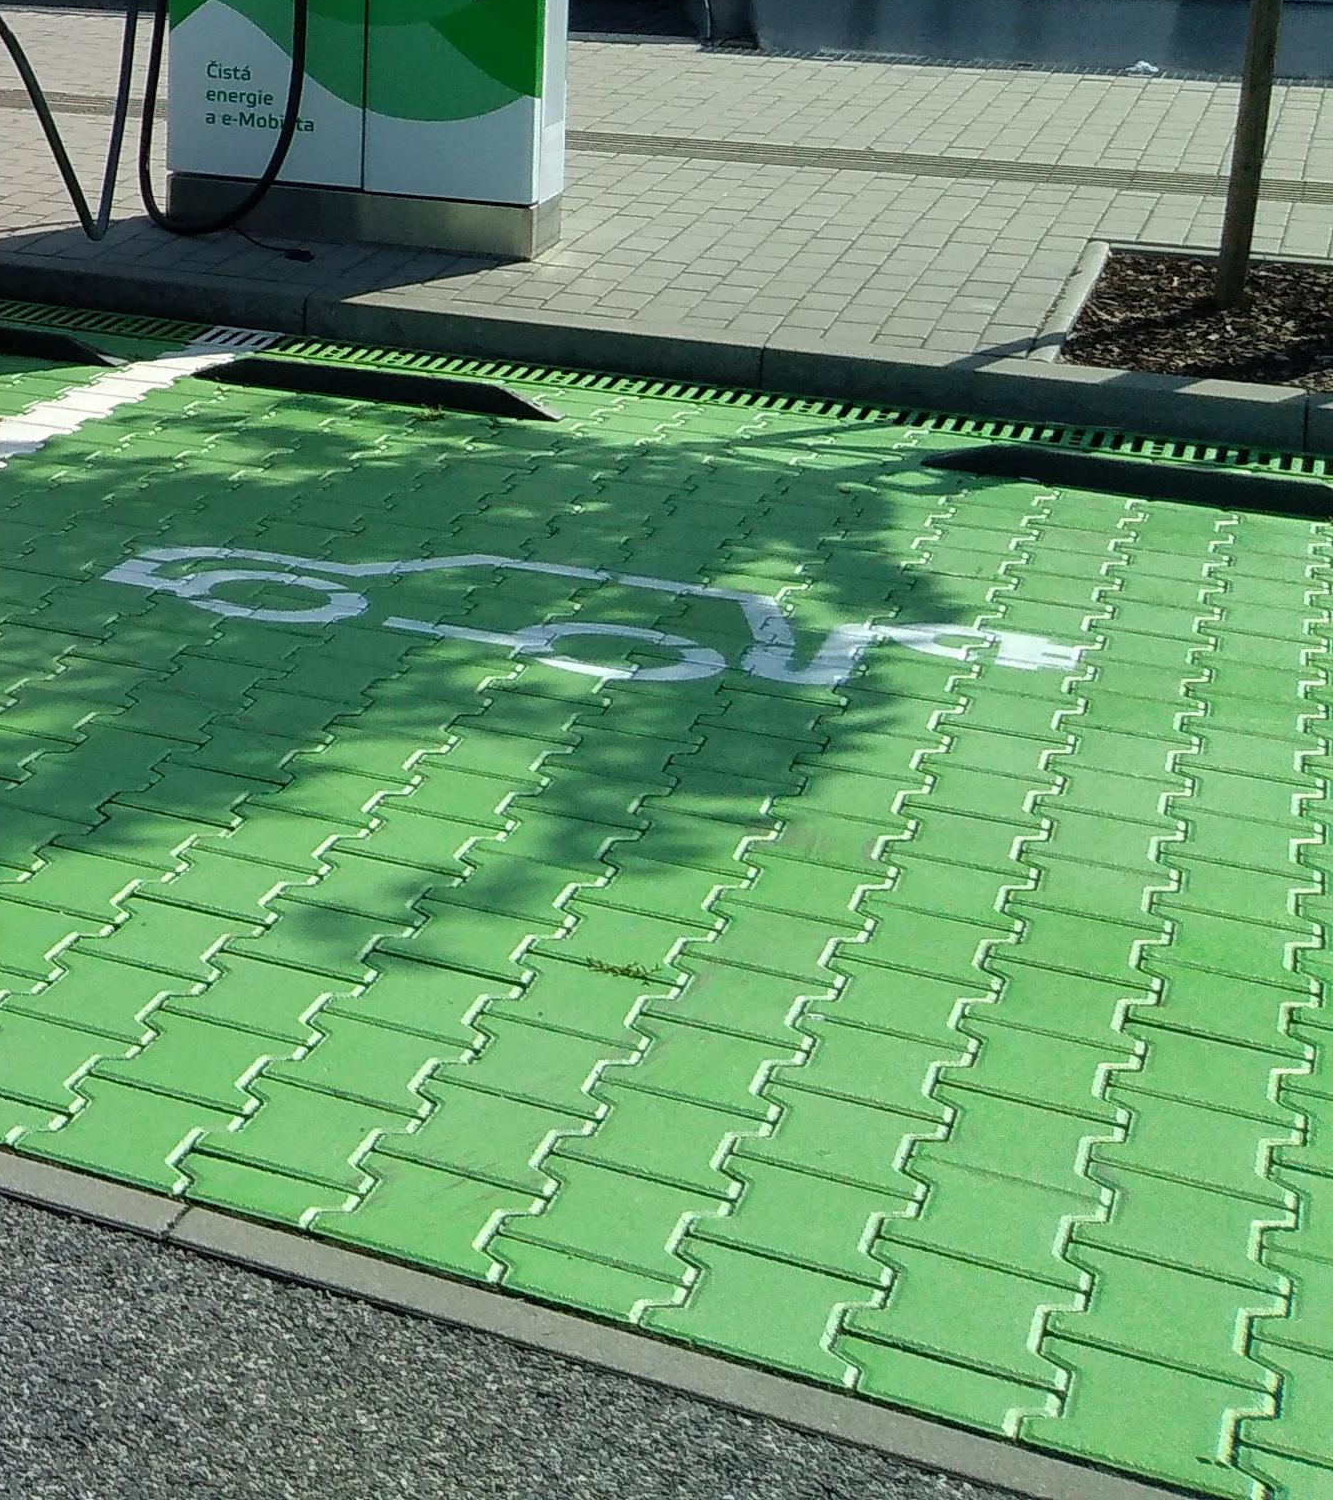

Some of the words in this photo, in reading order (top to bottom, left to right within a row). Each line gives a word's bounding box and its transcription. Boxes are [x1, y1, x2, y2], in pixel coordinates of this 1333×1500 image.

[205, 60, 252, 81] Čistá
[205, 89, 274, 108] energie
[205, 112, 216, 125] a
[221, 111, 315, 132] e-Mobita
